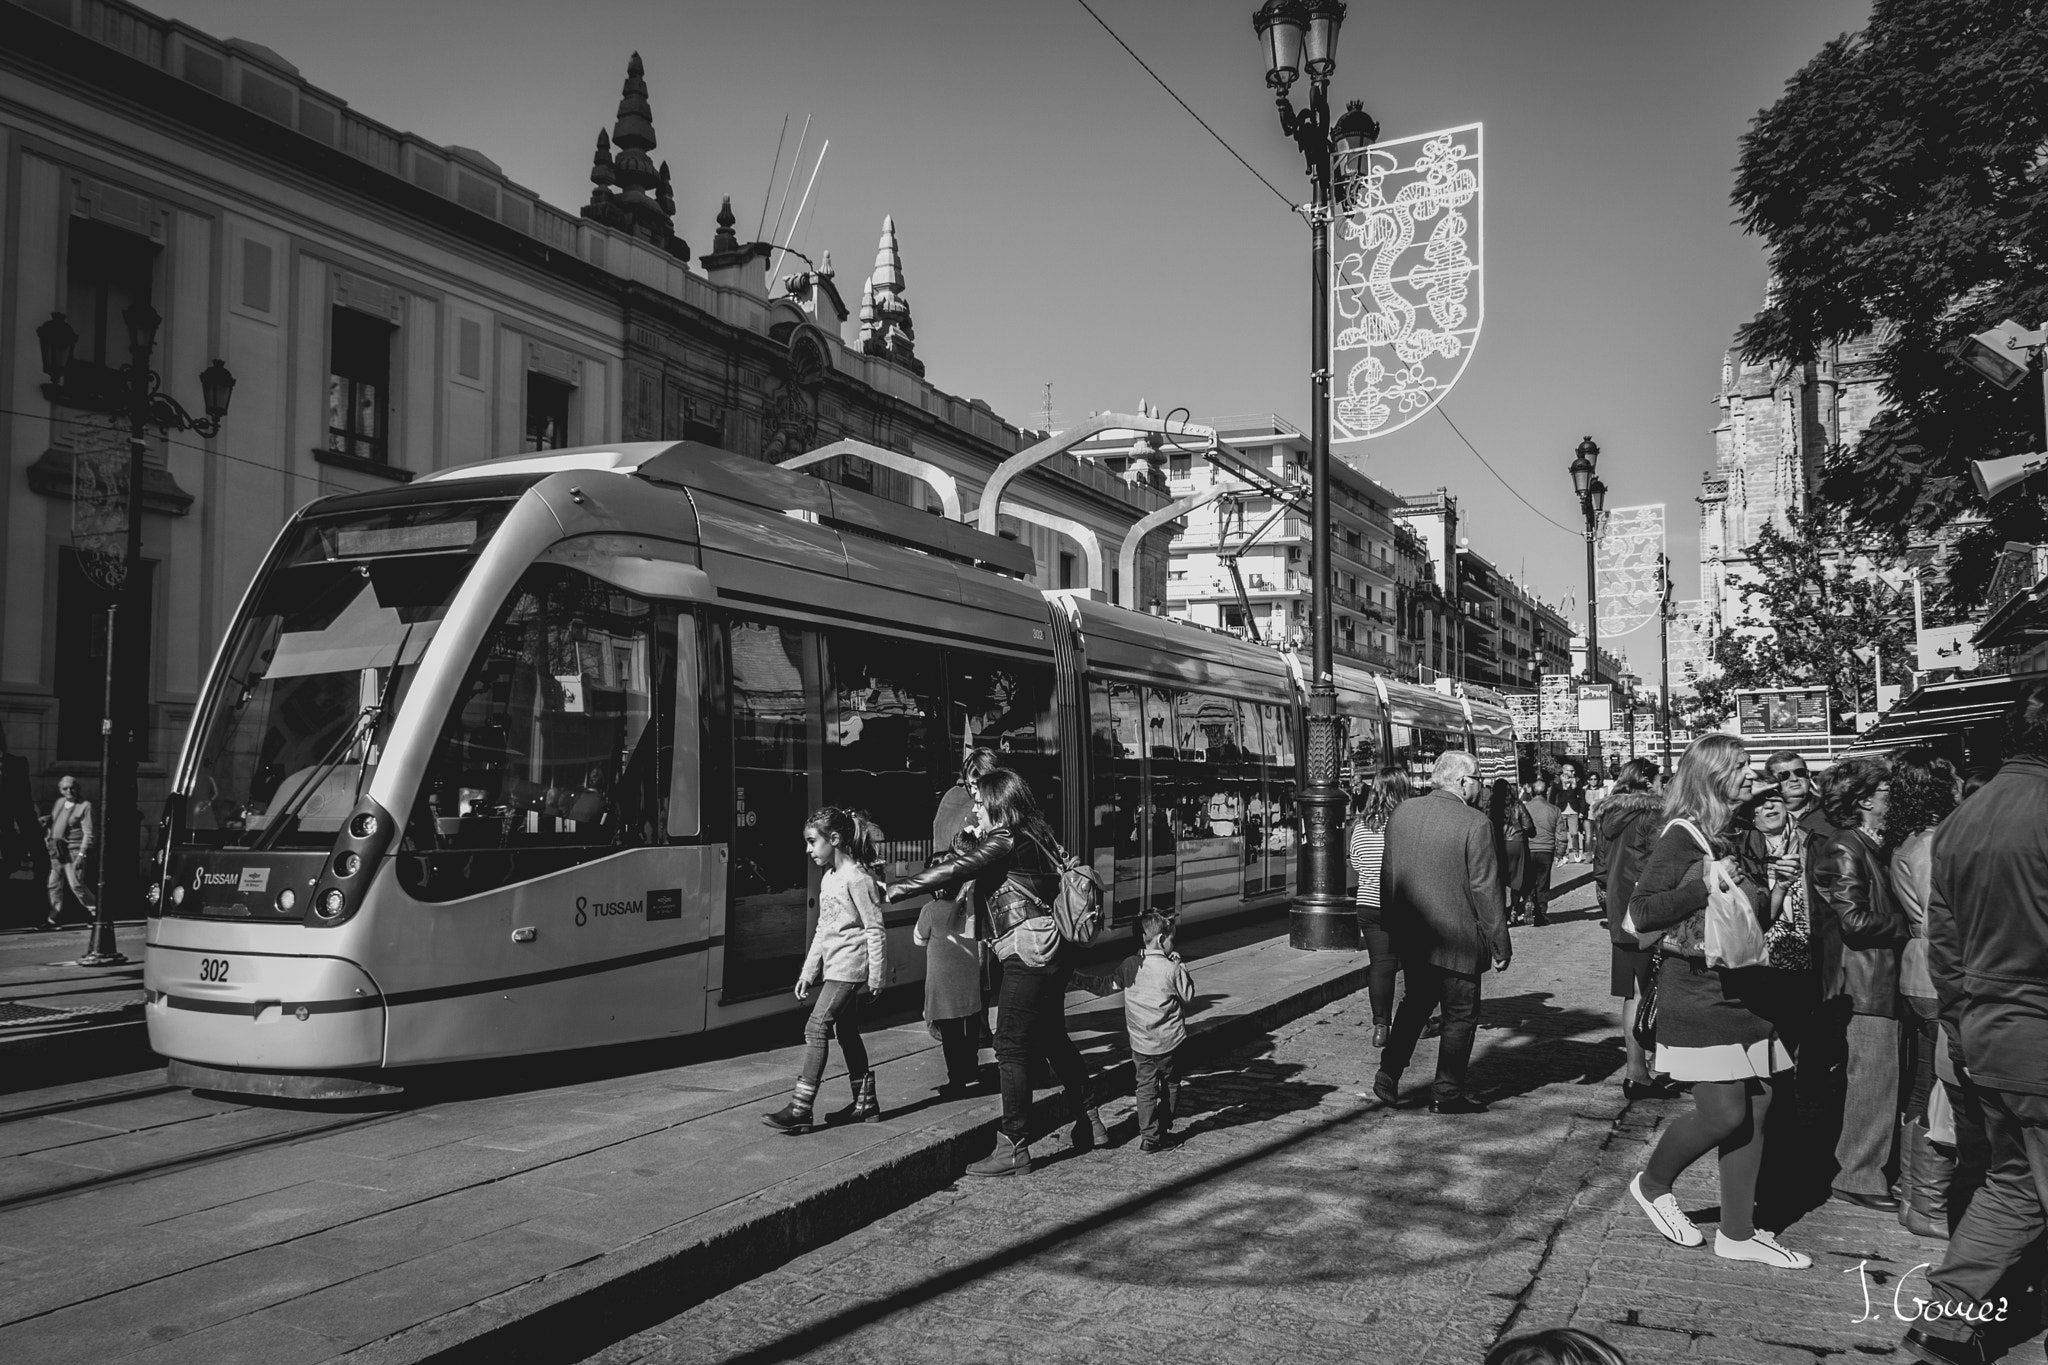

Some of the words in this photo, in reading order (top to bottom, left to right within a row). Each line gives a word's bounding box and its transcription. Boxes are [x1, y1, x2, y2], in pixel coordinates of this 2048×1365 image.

[1032, 628, 1044, 640] 302
[203, 873, 239, 885] TUSSAM
[592, 900, 643, 917] TUSSAM
[200, 958, 229, 982] 302
